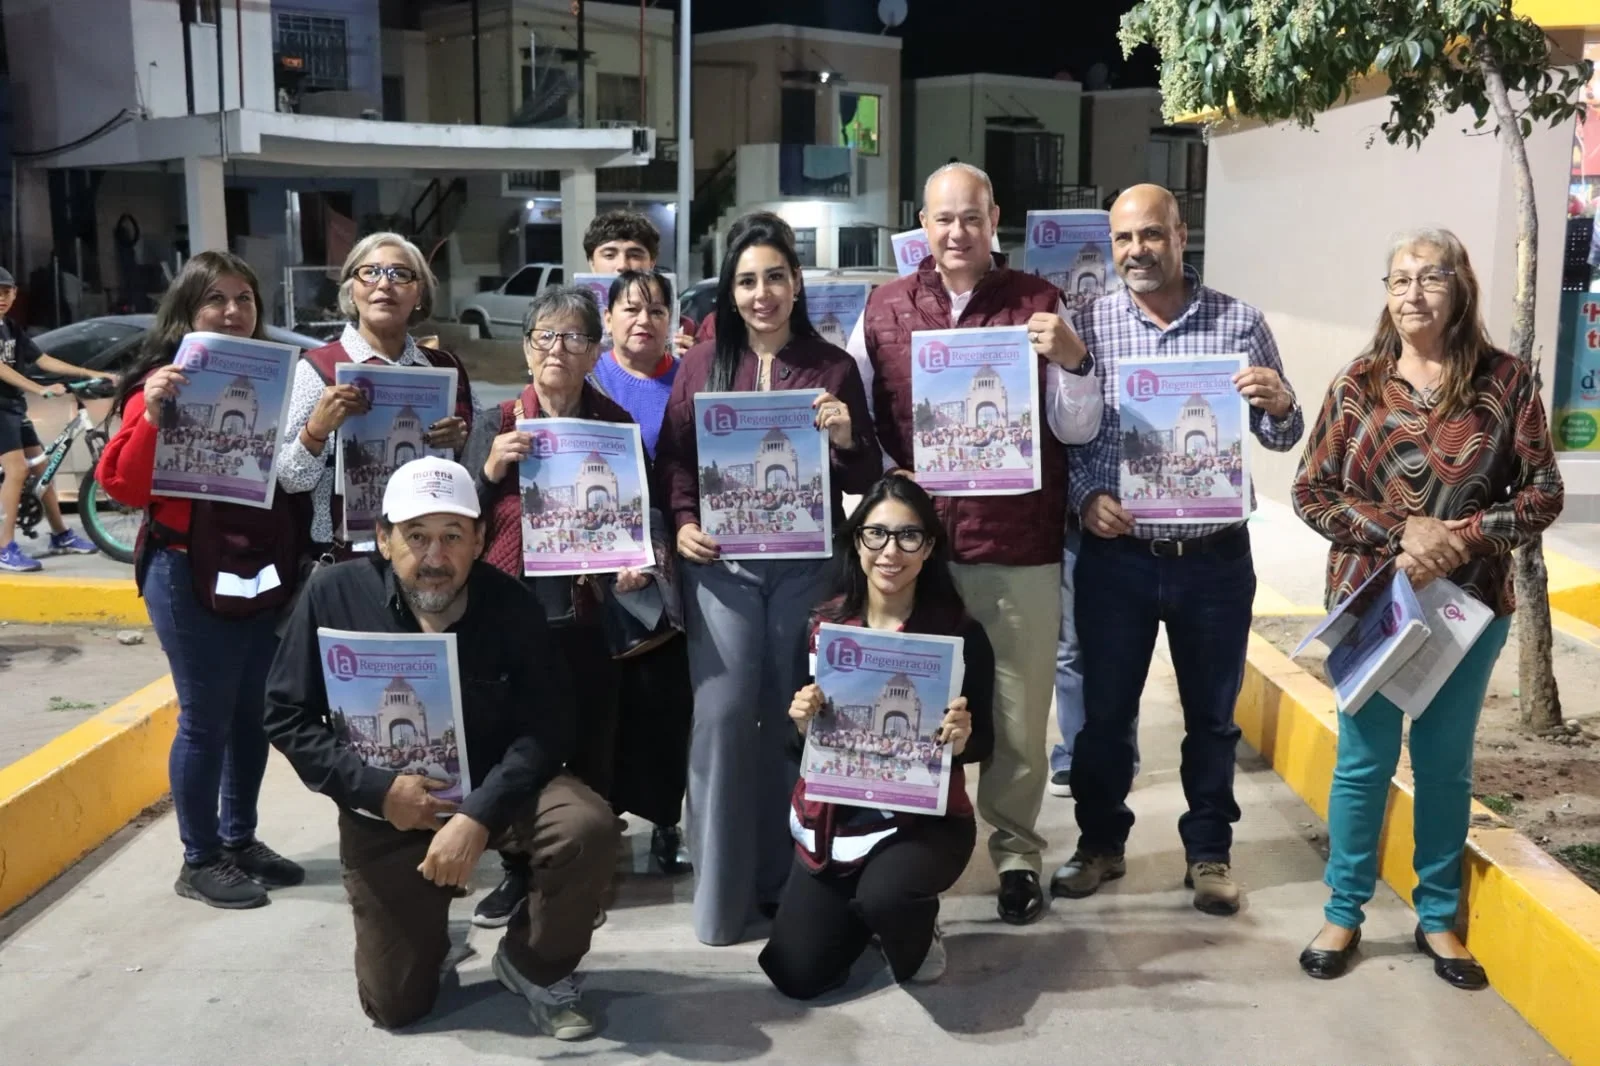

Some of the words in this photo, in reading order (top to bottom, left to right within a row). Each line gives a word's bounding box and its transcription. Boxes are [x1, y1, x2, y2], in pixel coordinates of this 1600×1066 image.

[919, 343, 946, 371] La
[1131, 372, 1155, 399] La
[709, 407, 733, 433] La
[739, 411, 810, 427] Regeneración
[412, 470, 453, 481] morena
[332, 647, 353, 676] La
[359, 658, 437, 674] Regeneración
[832, 640, 857, 669] La
[864, 653, 941, 674] Regeneración
